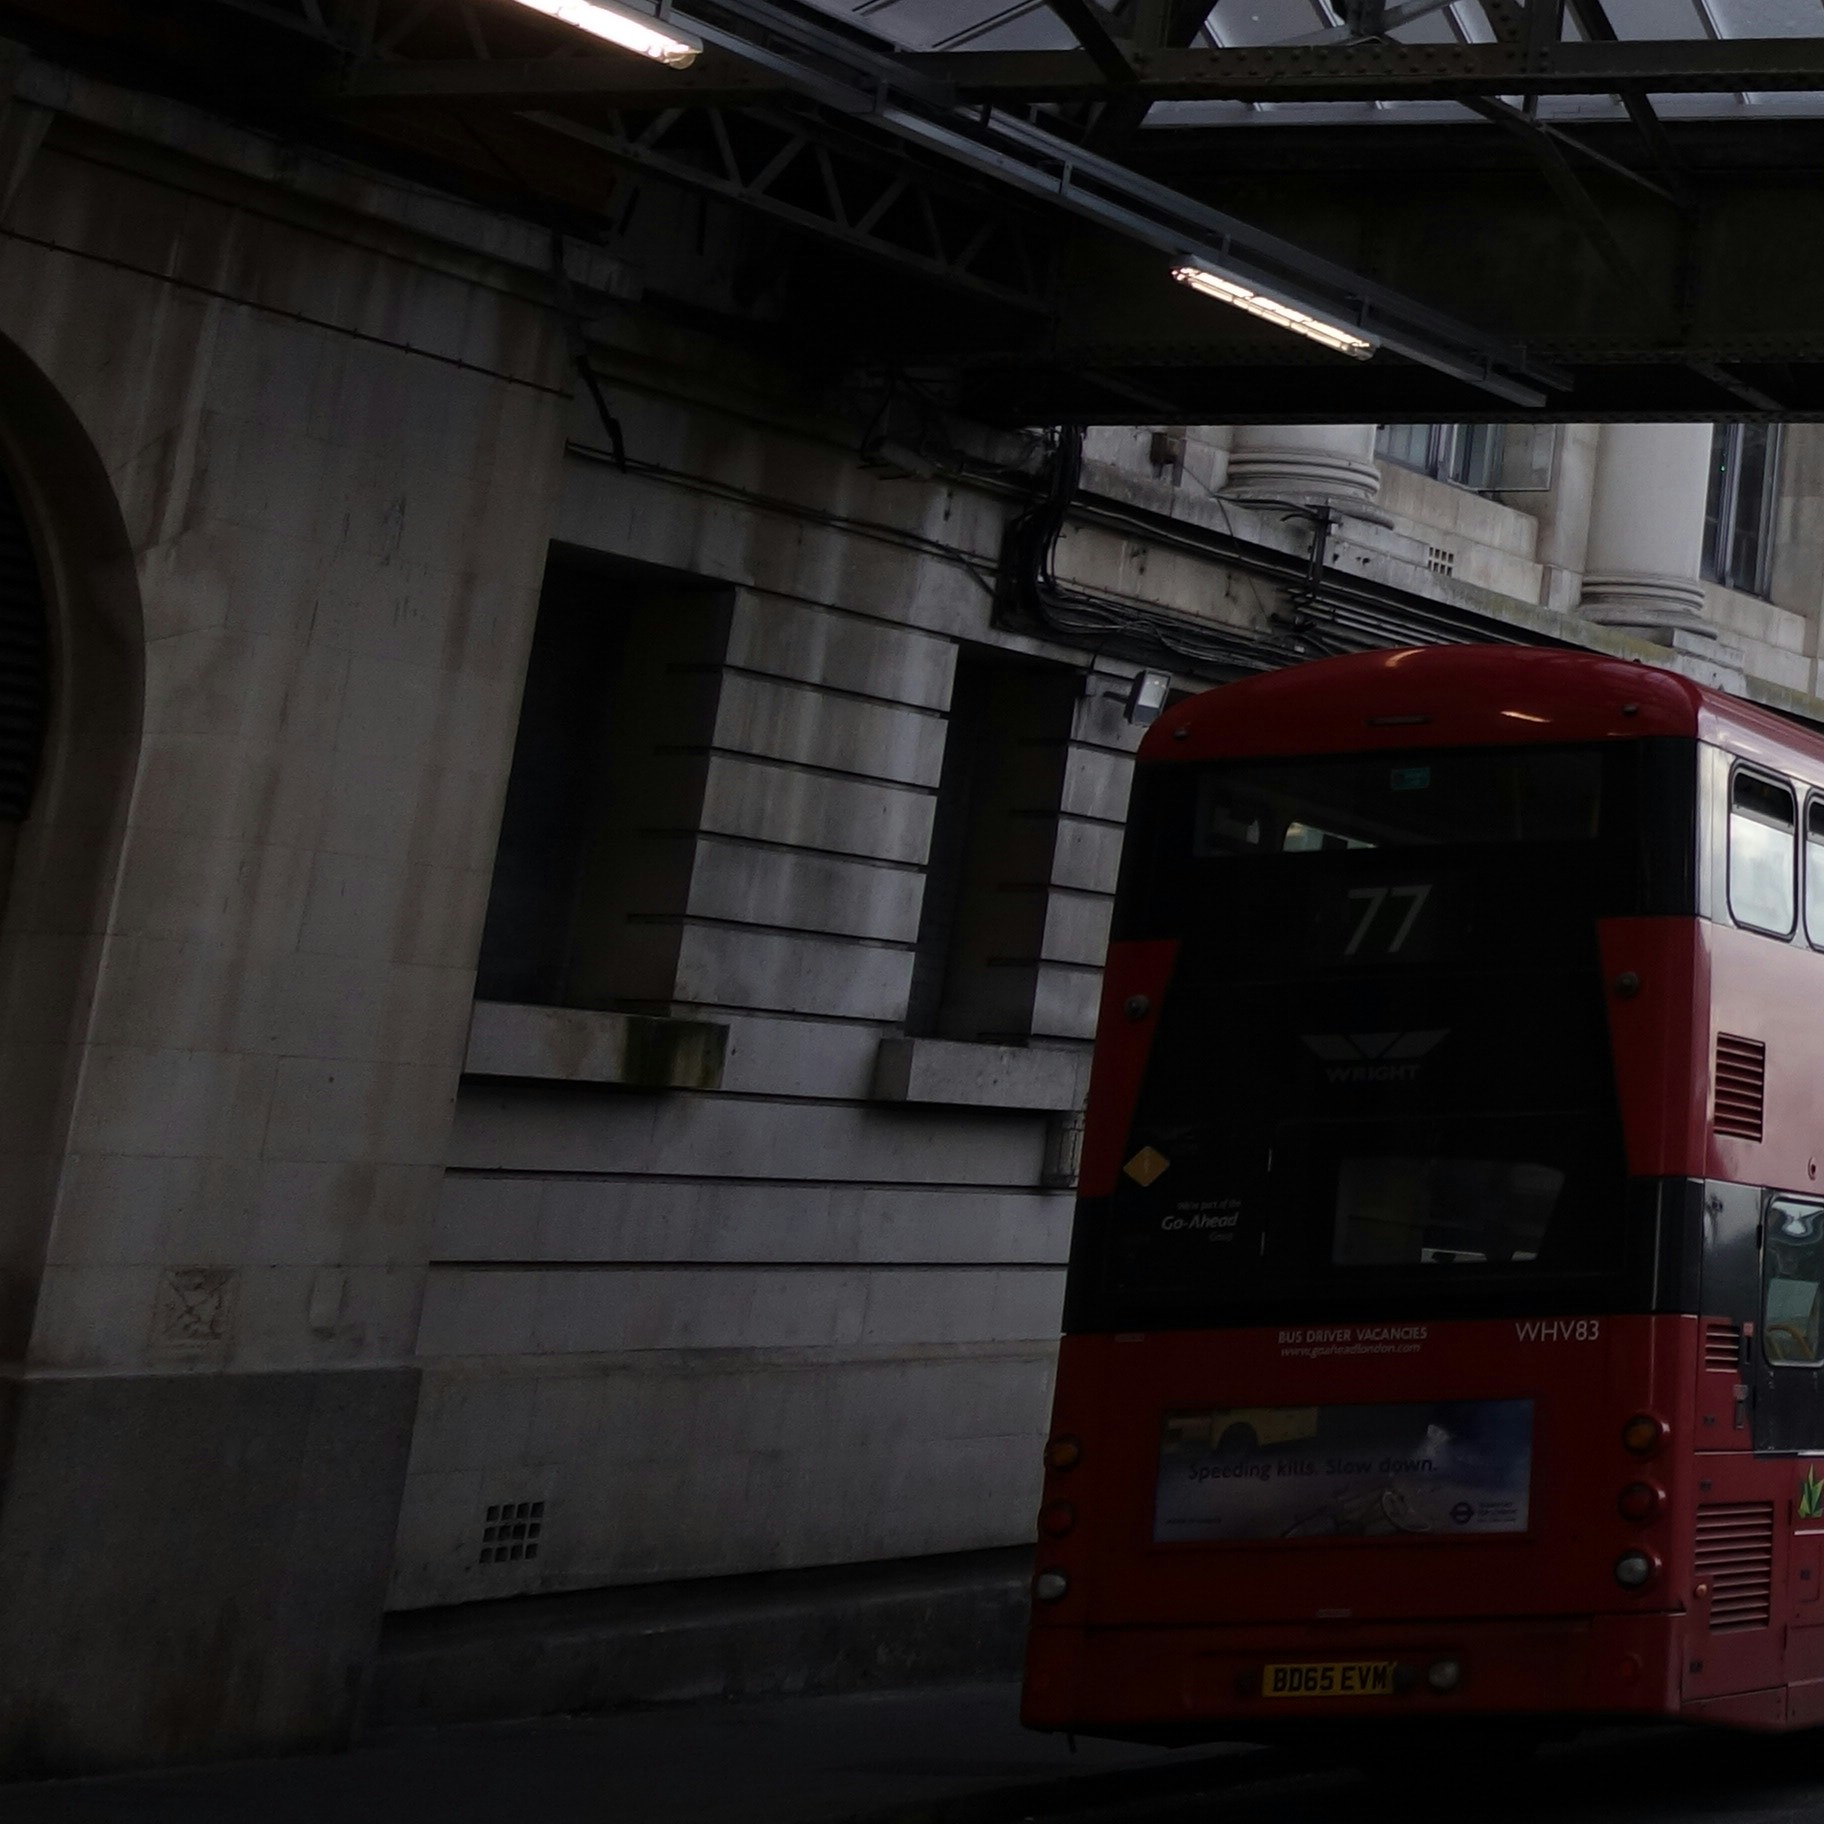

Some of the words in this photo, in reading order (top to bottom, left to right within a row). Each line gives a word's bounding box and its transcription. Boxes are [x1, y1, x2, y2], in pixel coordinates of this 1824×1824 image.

[1344, 884, 1434, 956] 77
[1325, 1064, 1422, 1084] WRIGHT
[1160, 1211, 1240, 1231] Go-Ahead
[1278, 1330, 1302, 1345] BUS
[1305, 1328, 1352, 1344] DRIVER
[1355, 1325, 1428, 1342] VACANCIES
[1515, 1319, 1600, 1343] WHV83
[1187, 1460, 1271, 1481] Speeding
[1275, 1460, 1321, 1477] kills.
[1325, 1458, 1373, 1476] Slow
[1379, 1455, 1439, 1475] down.
[1272, 1666, 1335, 1693] BD65
[1340, 1664, 1387, 1692] EVM
